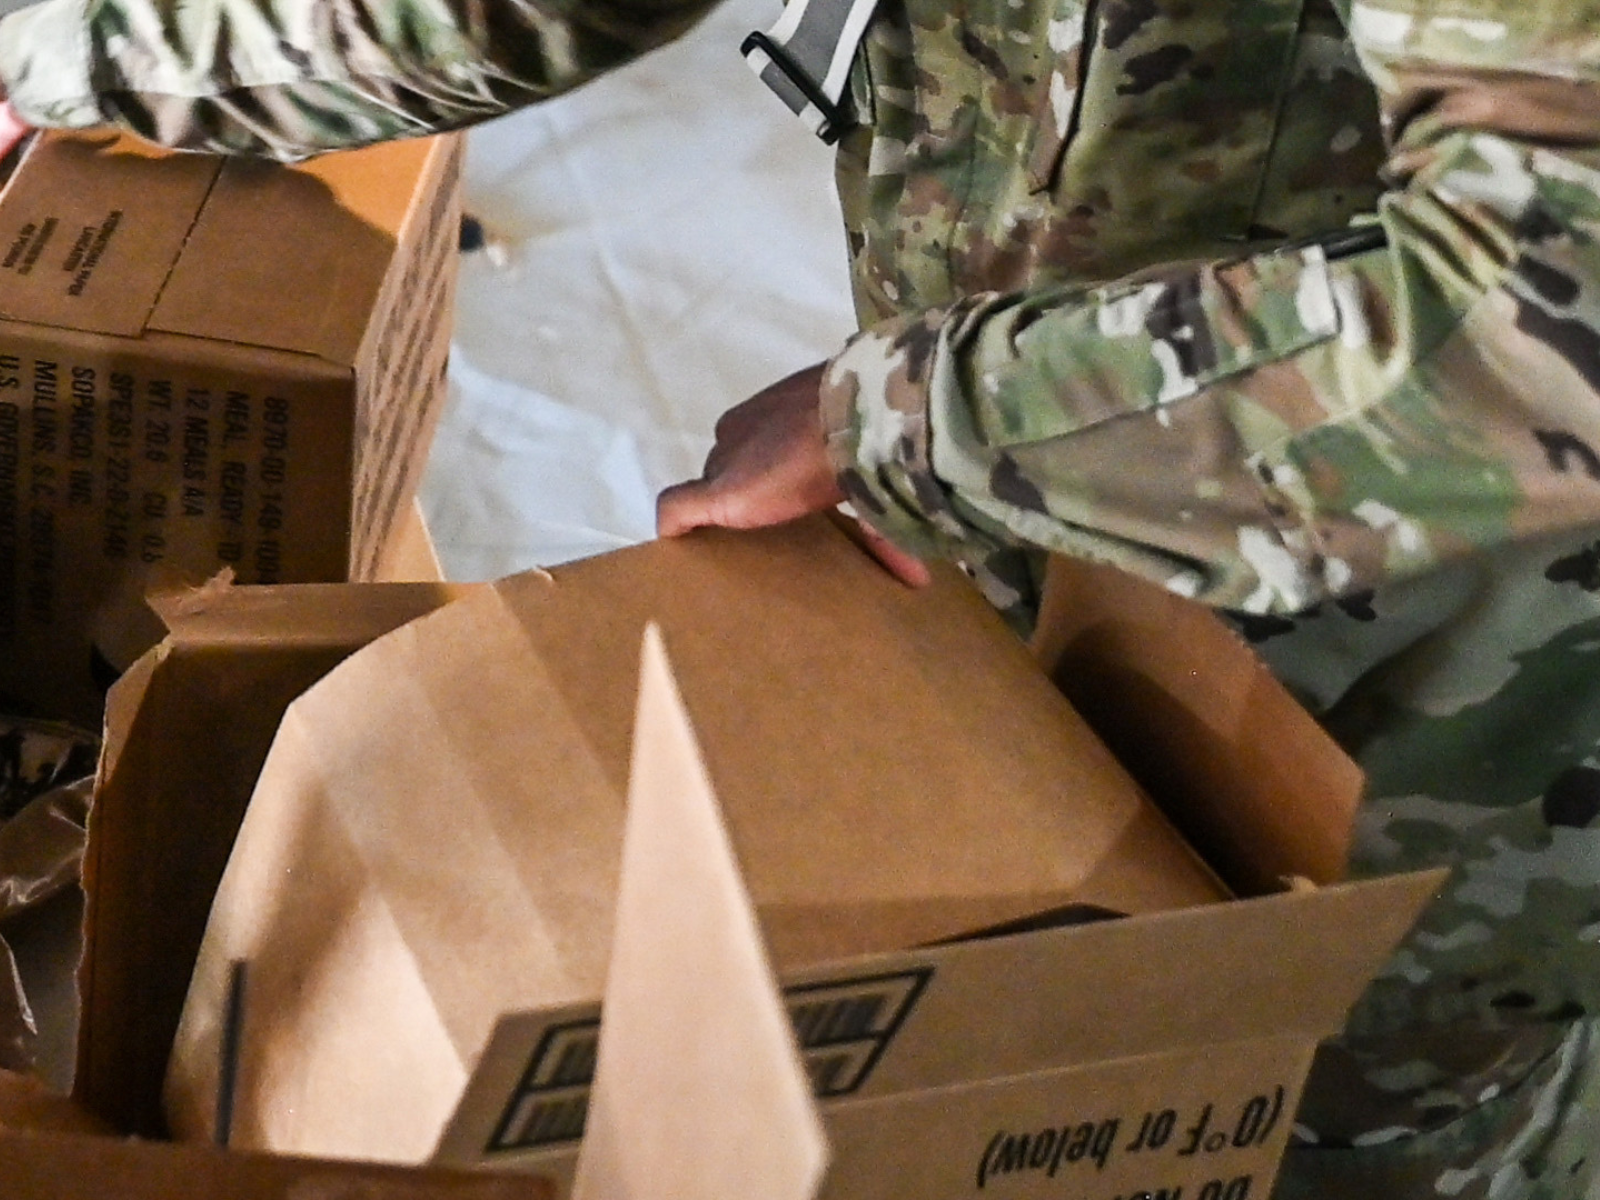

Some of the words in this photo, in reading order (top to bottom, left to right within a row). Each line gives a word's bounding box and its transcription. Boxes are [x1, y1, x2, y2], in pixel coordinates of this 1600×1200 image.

[187, 388, 211, 409] 12
[183, 415, 209, 480] MEALS
[975, 1118, 1121, 1191] below)
[1125, 1108, 1177, 1153] or
